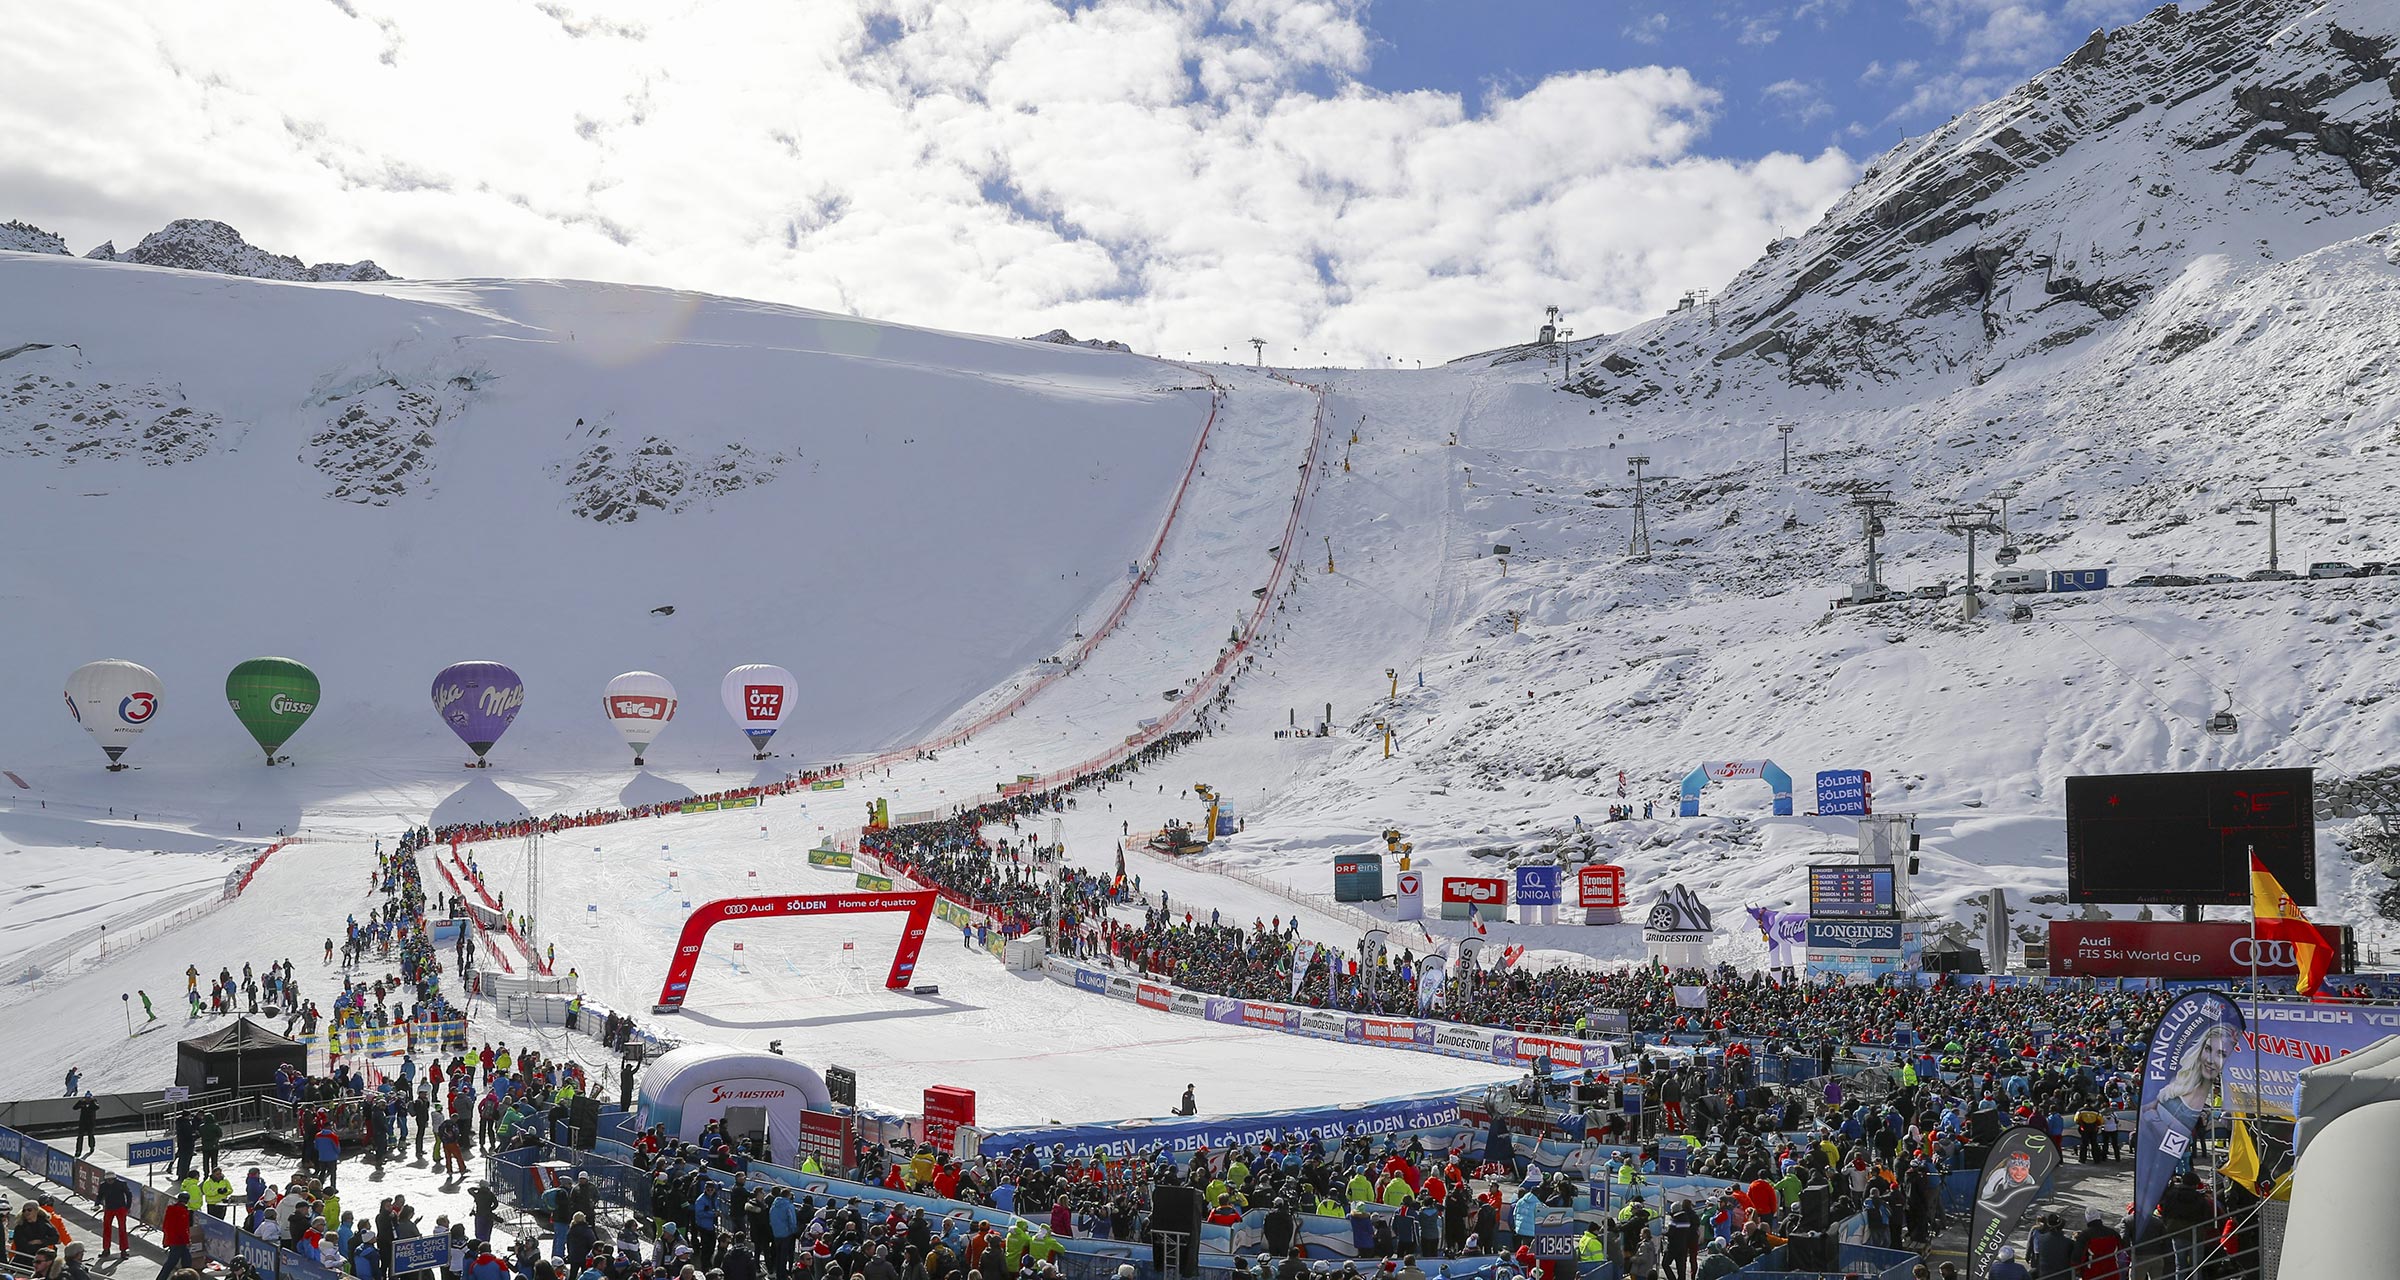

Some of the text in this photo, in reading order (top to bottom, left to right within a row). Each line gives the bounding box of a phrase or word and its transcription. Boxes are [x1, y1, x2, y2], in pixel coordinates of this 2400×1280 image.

[749, 689, 779, 705] ÖTZ
[616, 701, 661, 717] Tirol
[750, 706, 776, 716] TAL
[1817, 775, 1862, 789] SÖLDEN
[1818, 787, 1862, 802] SÖLDEN
[1819, 801, 1863, 815] SÖLDEN
[1336, 863, 1379, 873] ORF eins
[1583, 876, 1612, 885] Kronen
[1448, 881, 1496, 900] Tirol
[1517, 890, 1551, 899] UNIQA
[1583, 886, 1612, 896] Zeitung
[750, 898, 917, 912] Audi SÖLDEN Home of quattro
[1645, 933, 1704, 943] BRIDGESTONE
[1814, 924, 1894, 938] LONGINES
[2079, 936, 2111, 946] Audi
[2078, 949, 2201, 963] FIS Ski World Cup
[2168, 983, 2229, 998] SÖEN
[1170, 1002, 1205, 1017] BRIDGESTONE
[1212, 999, 1237, 1021] Milka
[1302, 1017, 1345, 1033] BRIDGESTONE
[1365, 1021, 1414, 1039] Kronen Zeitung
[1436, 1033, 1491, 1052] BRIDGESTONE
[2150, 999, 2199, 1081] FANCLUB
[2169, 1016, 2205, 1072] EVAMARIABREM
[1517, 1040, 1582, 1064] Kronen Zeitung
[707, 1084, 785, 1104] SKI AUSTRIA
[1408, 1106, 1460, 1128] SÖLDEN
[1354, 1115, 1404, 1136] ÖLDEN
[1138, 1132, 1209, 1155] SÖDEN
[1214, 1128, 1277, 1148] SÖLDEN
[131, 1146, 172, 1160] TRIBÜNE
[49, 1156, 73, 1178] SÖLDEN
[1669, 1159, 1676, 1171] 5
[1595, 1191, 1602, 1204] 4
[1974, 1217, 2001, 1256] Fan's Club
[396, 1243, 414, 1252] RACE
[422, 1238, 446, 1248] OFFICE
[396, 1250, 415, 1258] PRESS
[422, 1244, 446, 1254] OFFICE
[1540, 1236, 1572, 1255] 1345
[240, 1241, 275, 1272] SÖLDEN
[409, 1252, 434, 1262] TOILETS
[1974, 1230, 2005, 1277] LARA GUT
